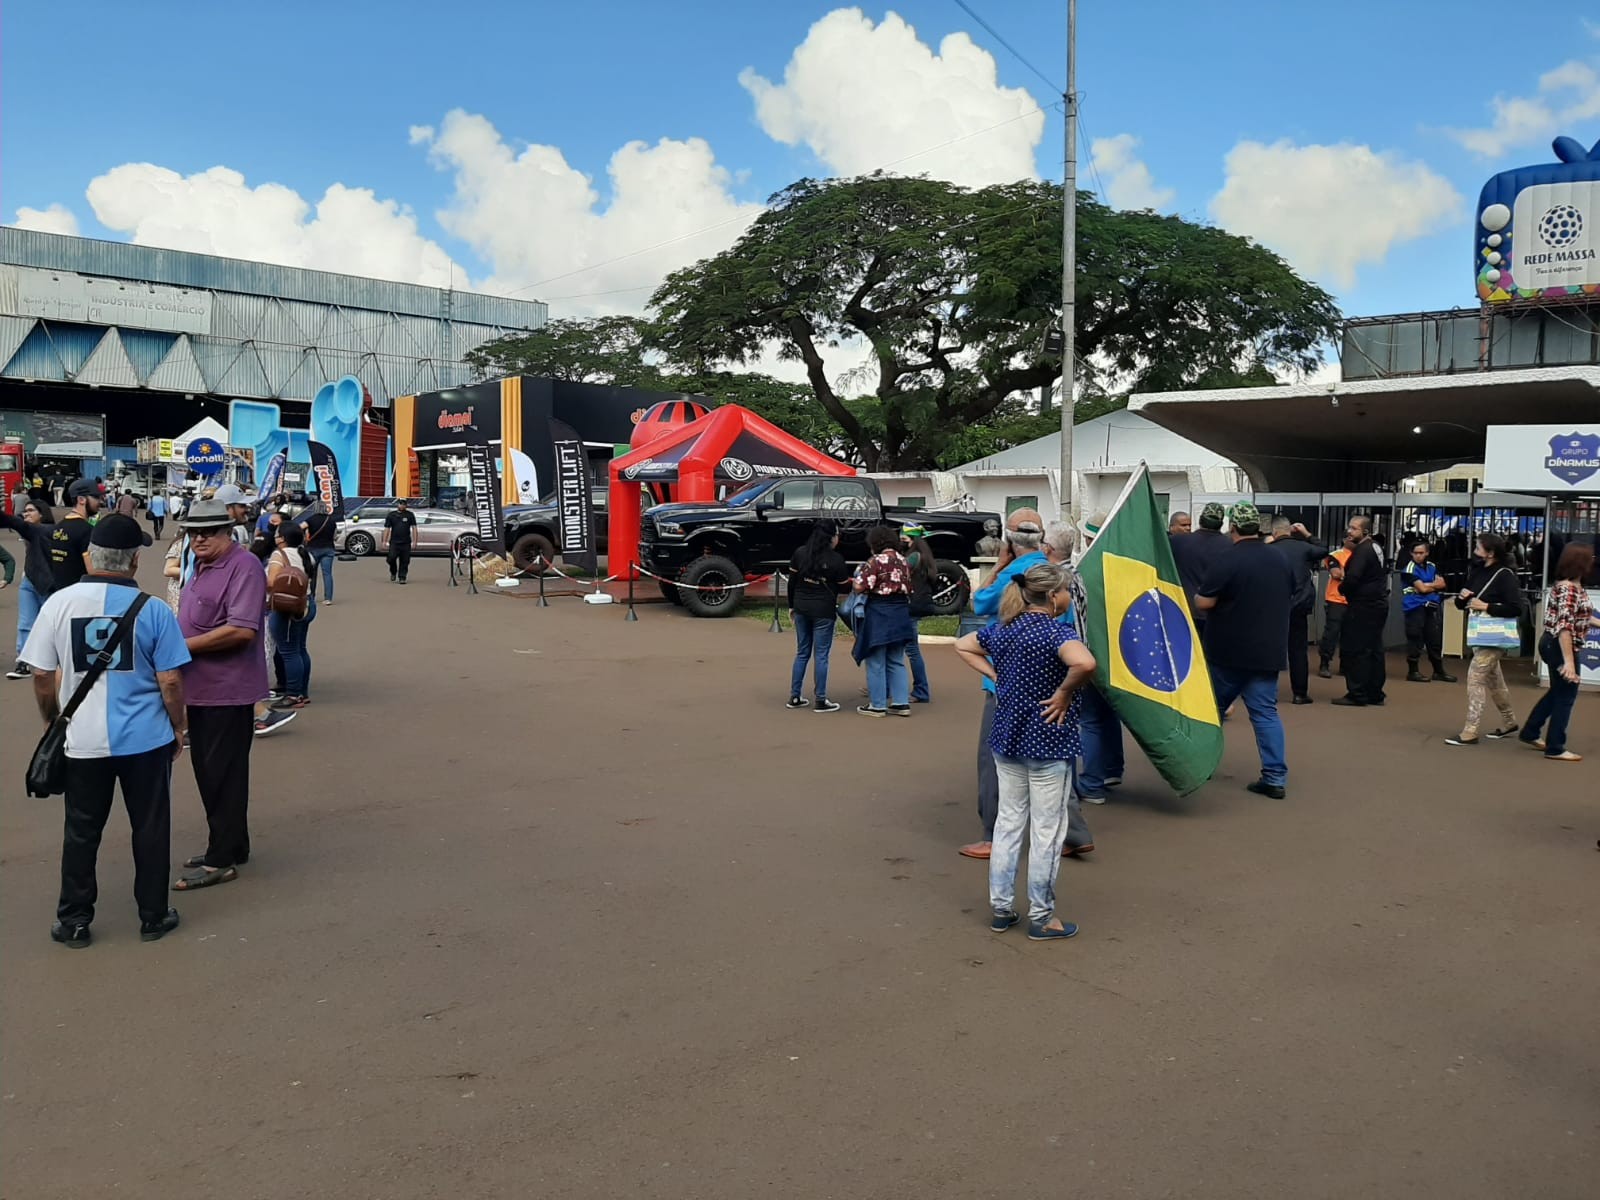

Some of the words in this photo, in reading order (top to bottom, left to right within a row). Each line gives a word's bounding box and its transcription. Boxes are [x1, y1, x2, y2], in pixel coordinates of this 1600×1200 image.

[1524, 253, 1553, 265] REDE
[1555, 249, 1596, 262] MASSA
[147, 302, 154, 310] E
[187, 454, 224, 464] donatti
[470, 450, 486, 476] LIFT
[560, 446, 578, 476] LIFT
[1548, 457, 1599, 467] DÍNAMUS
[473, 478, 493, 538] MONSTER
[563, 479, 582, 549] MONSTER
[85, 618, 121, 669] 9
